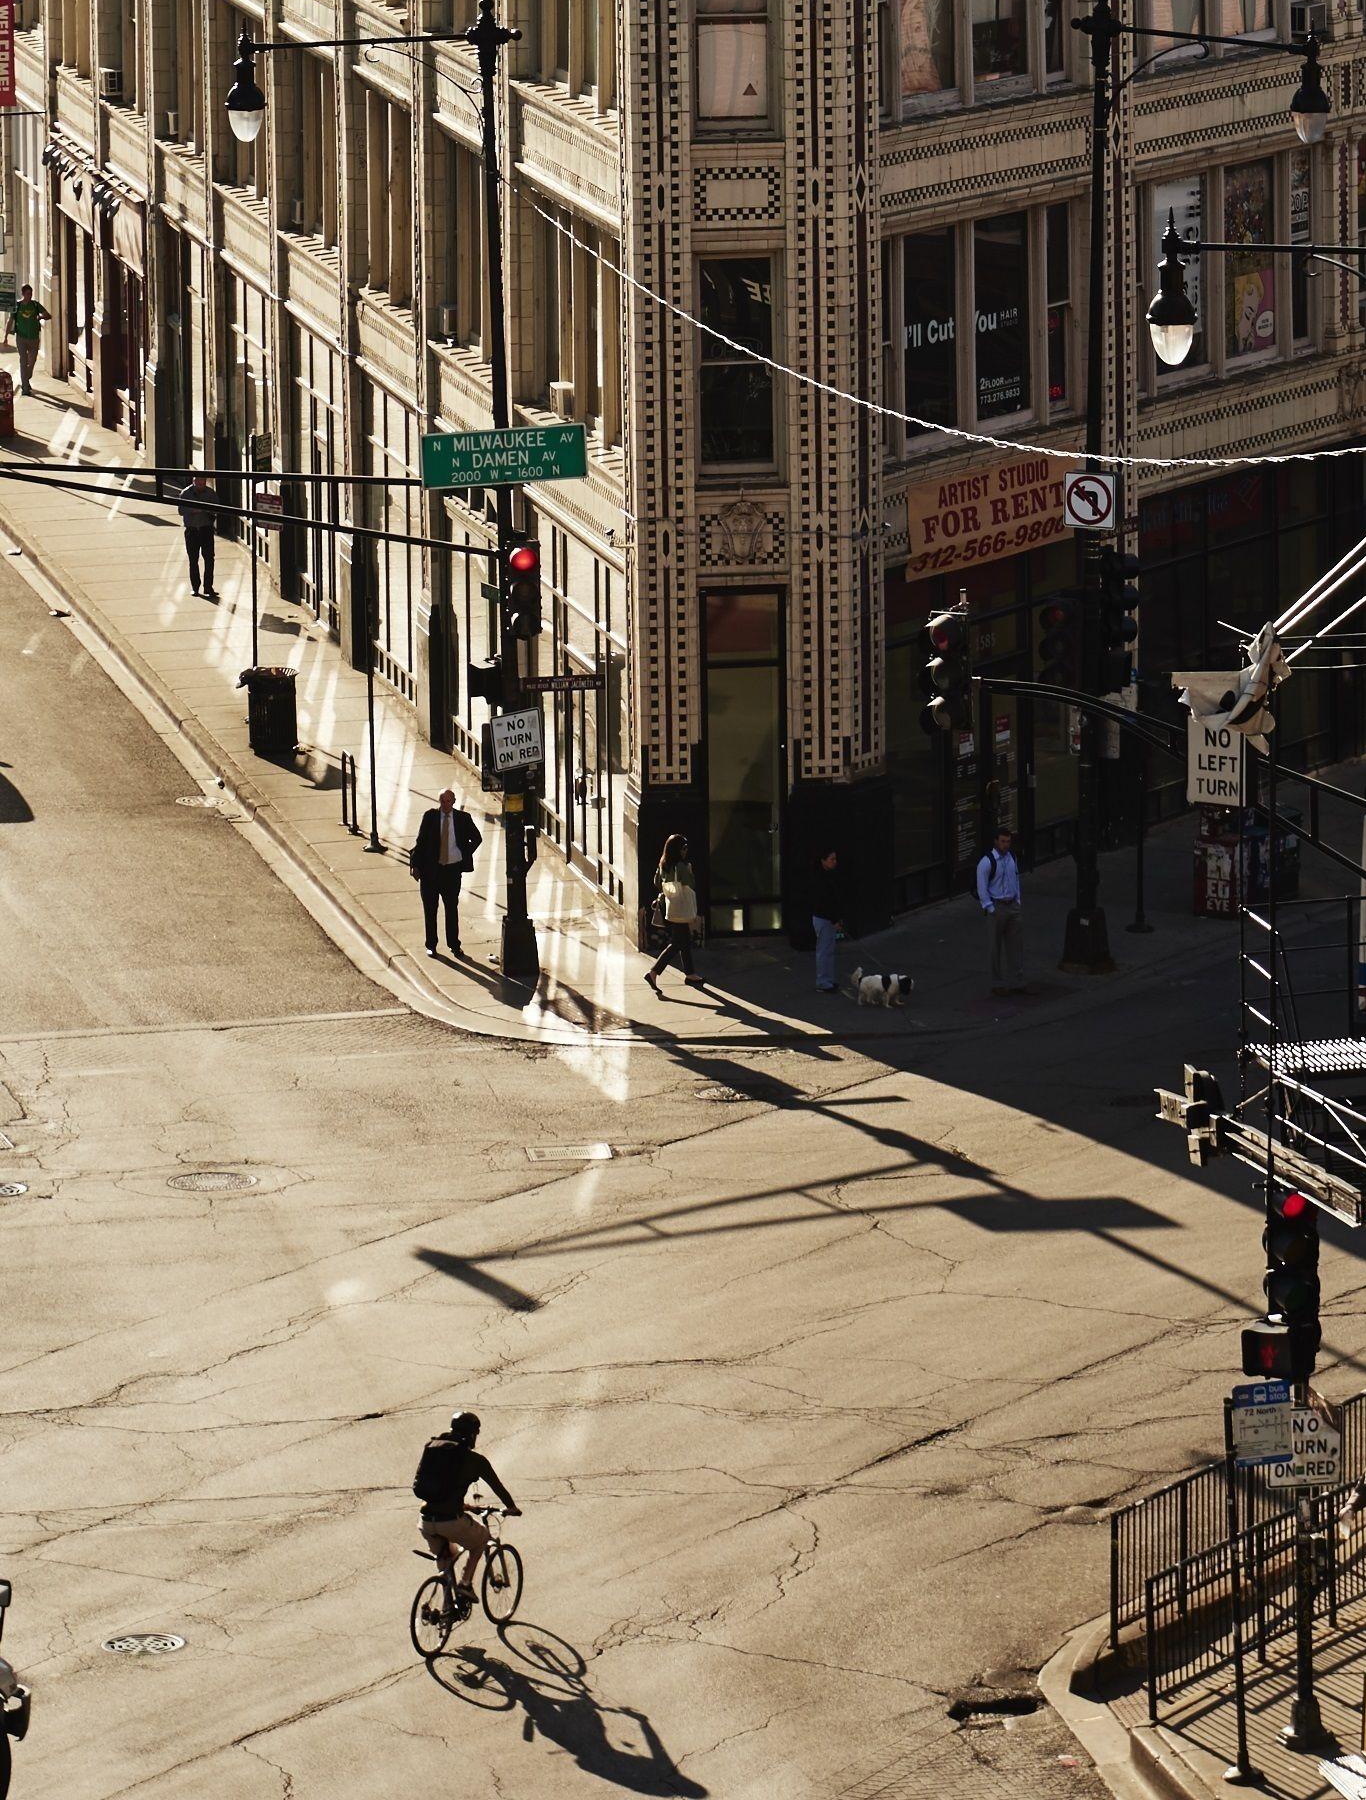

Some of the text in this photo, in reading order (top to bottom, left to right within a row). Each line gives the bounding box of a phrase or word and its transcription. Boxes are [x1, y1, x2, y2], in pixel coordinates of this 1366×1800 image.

[1000, 307, 1018, 320] HAIR
[927, 316, 955, 344] Cut
[433, 431, 574, 452] N MILWAUKEE AV
[452, 450, 556, 468] N DAMEN AV
[451, 471, 481, 483] 2000
[490, 469, 499, 479] W
[518, 466, 543, 477] 1600
[552, 465, 560, 476] N
[938, 458, 1049, 509] ARTIST STUDIO
[922, 481, 1064, 544] FOR RENT
[507, 718, 525, 732] NO
[503, 732, 532, 747] TURN
[1204, 728, 1231, 748] NO
[499, 746, 539, 763] ON RED
[1198, 755, 1238, 773] LEFT
[1196, 778, 1239, 797] TURN
[1206, 900, 1230, 912] EYE
[1268, 1384, 1284, 1393] bus
[1268, 1392, 1288, 1401] stop
[1256, 1407, 1277, 1415] North
[1292, 1418, 1319, 1433] NO
[1294, 1439, 1327, 1455] URN
[1274, 1461, 1336, 1478] ON RED
